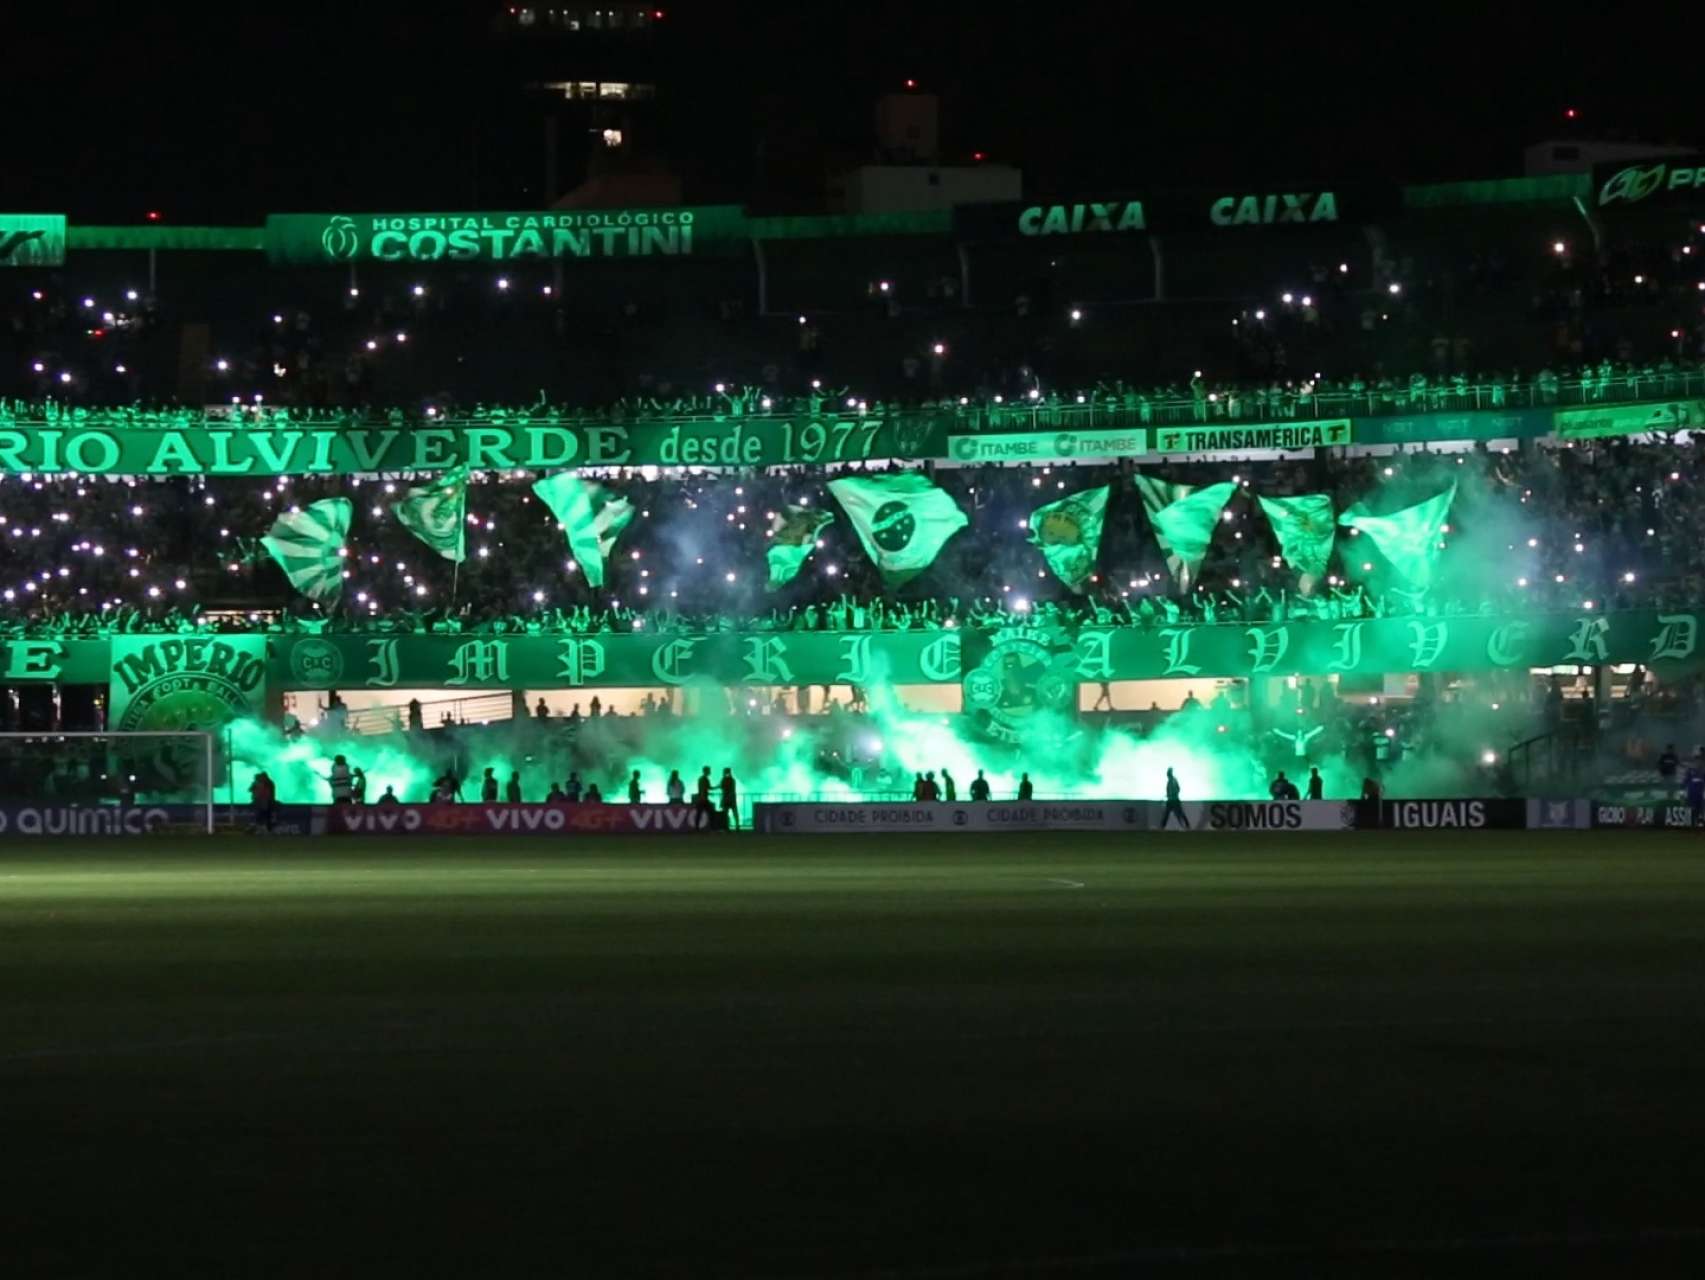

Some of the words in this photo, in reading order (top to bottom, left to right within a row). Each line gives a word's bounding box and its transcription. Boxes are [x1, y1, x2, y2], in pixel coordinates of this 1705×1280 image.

[372, 216, 494, 231] HOSPITAL
[505, 210, 694, 229] CARDIOLÓGICO
[1018, 201, 1147, 236] CAIXA
[1209, 191, 1339, 226] CAIXA
[370, 224, 693, 261] COSTANTINI
[146, 426, 632, 472] ALVIVERDE
[659, 424, 762, 464] desde
[781, 420, 884, 462] 1977
[1185, 425, 1323, 451] TRANSAMÉRICA
[814, 809, 866, 824] CIDADE
[871, 809, 934, 824] PROIBIDA
[1209, 802, 1302, 829] SOMOS
[1392, 801, 1486, 829] IGUAIS
